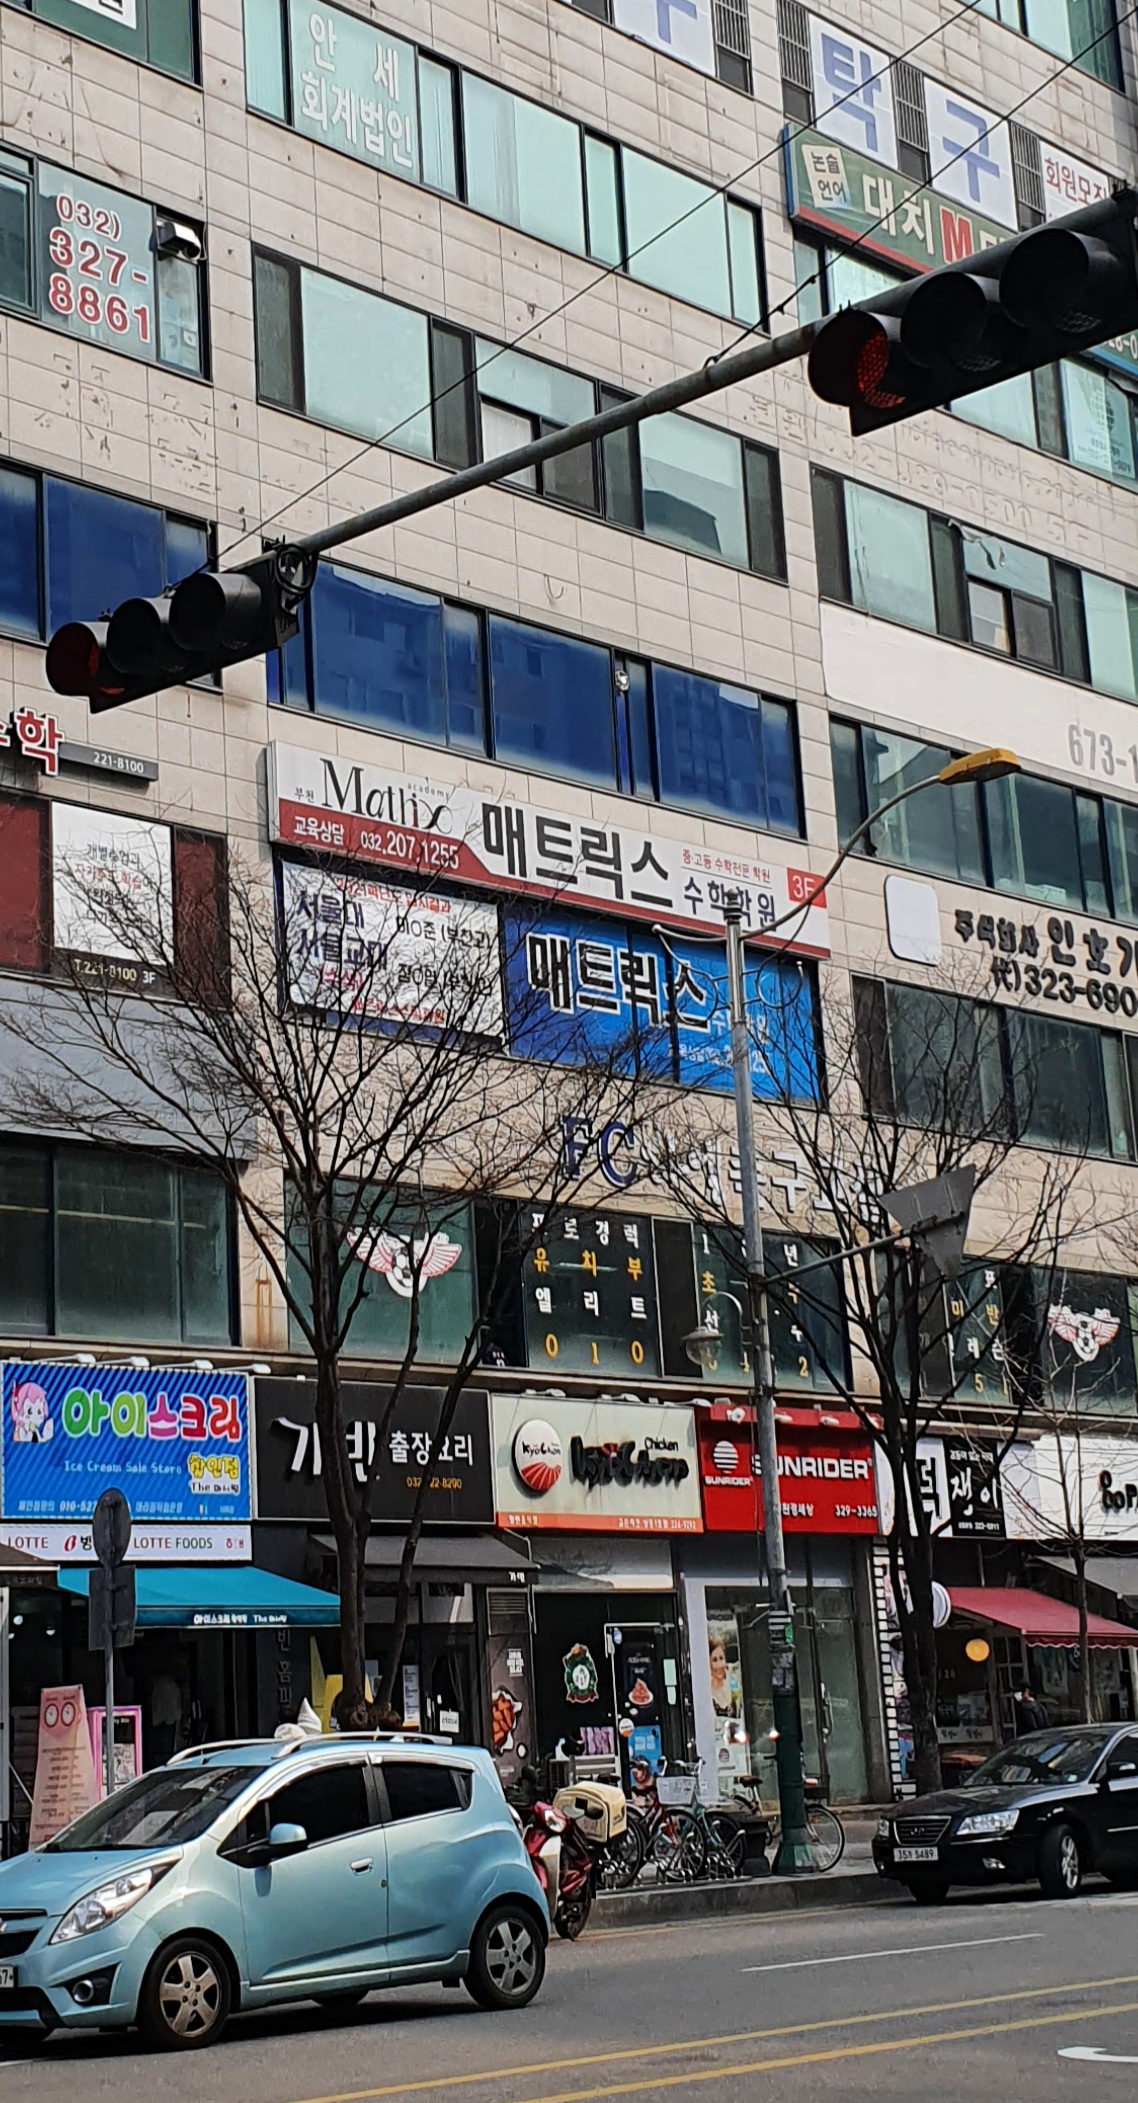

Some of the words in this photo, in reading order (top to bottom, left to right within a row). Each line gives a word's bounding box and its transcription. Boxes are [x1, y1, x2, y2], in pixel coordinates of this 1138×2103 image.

[301, 71, 414, 169] 회계법인
[811, 151, 841, 174] 논술
[817, 179, 848, 203] 언어
[56, 193, 122, 242] 032)
[48, 273, 151, 345] 8861
[93, 751, 145, 774] 221-8100
[294, 816, 345, 846] 교육상담
[482, 802, 672, 908] 매트릭스
[526, 932, 711, 1034] 매트릭스
[62, 1387, 242, 1443] 아이스크림
[64, 1460, 83, 1472] Ice
[8, 1537, 49, 1549] LOTTE
[134, 1537, 173, 1549] LOTTE
[175, 1537, 213, 1549] FOODS
